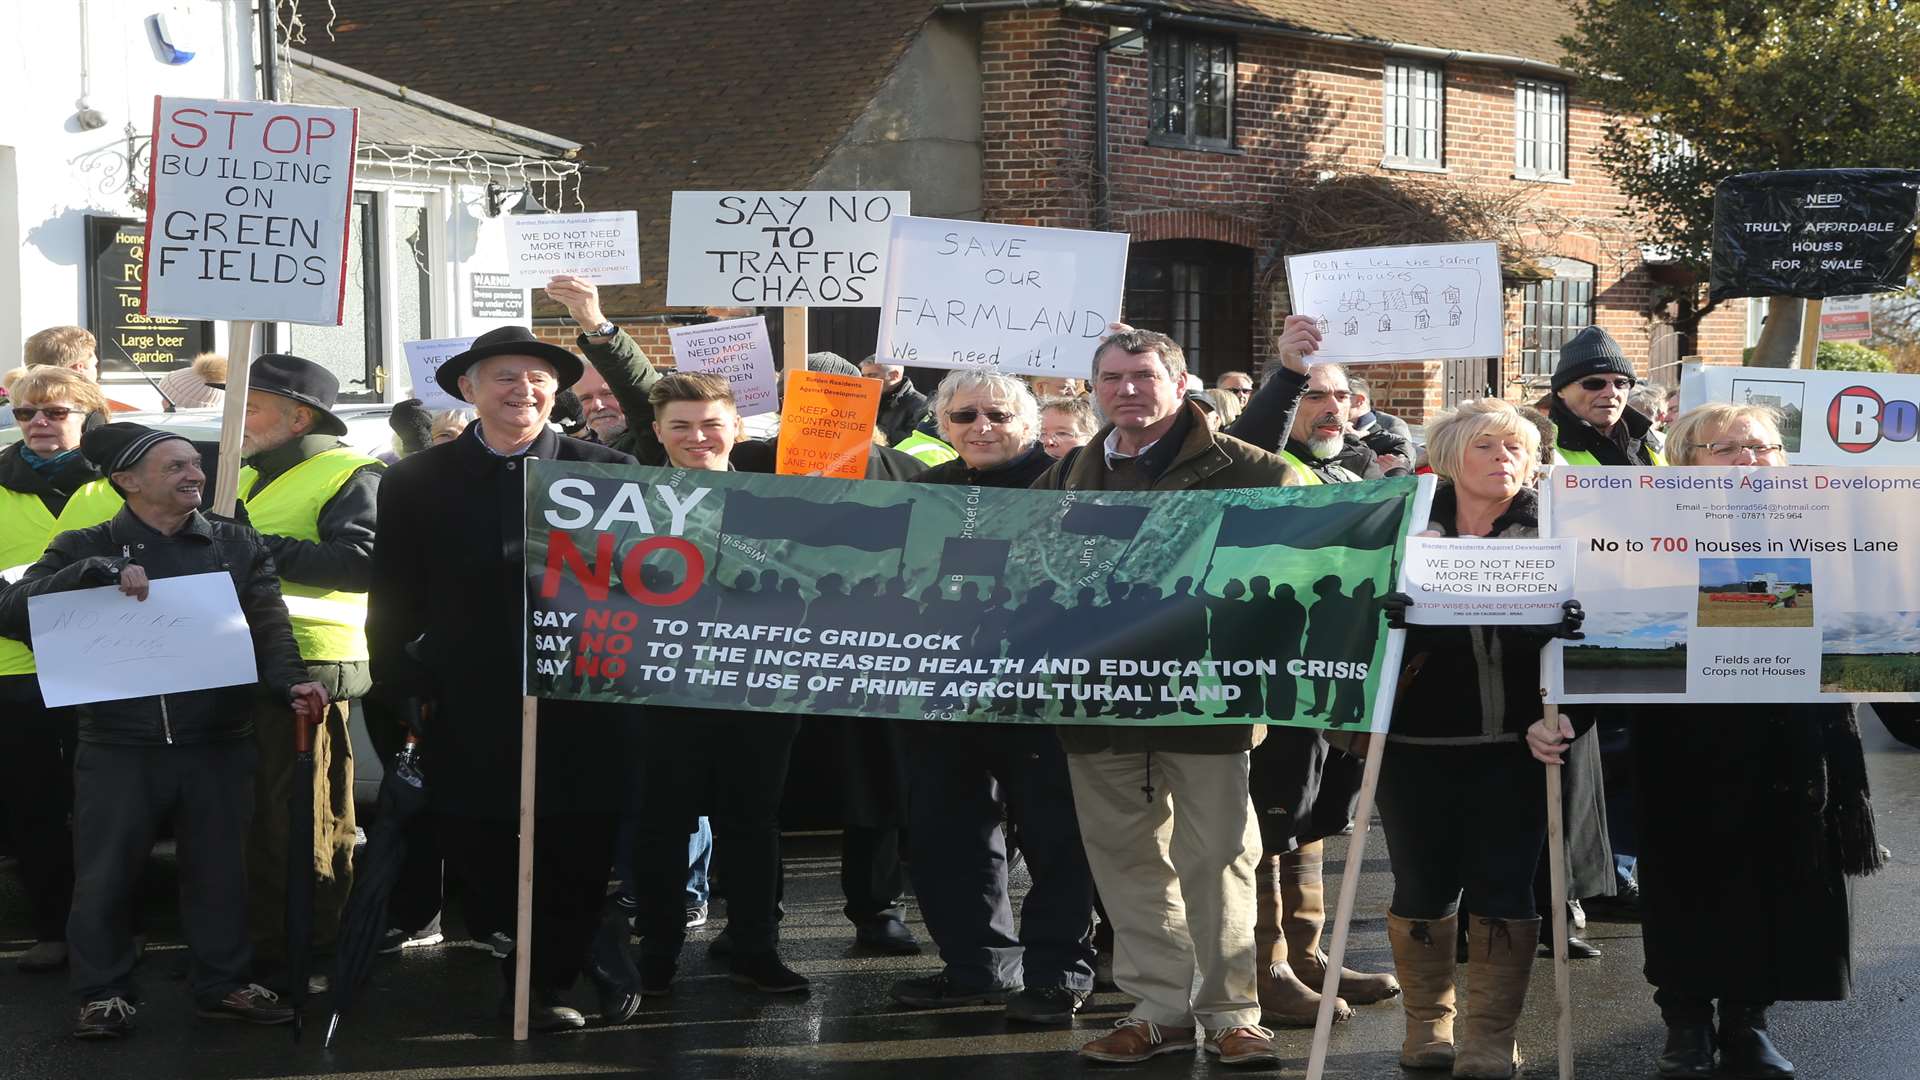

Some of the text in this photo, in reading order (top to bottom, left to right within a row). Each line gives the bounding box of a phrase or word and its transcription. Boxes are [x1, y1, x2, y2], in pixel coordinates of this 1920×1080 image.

[171, 108, 336, 155] STOP
[161, 154, 332, 184] BUILDING
[225, 185, 273, 208] ON
[1806, 193, 1843, 205] NEED
[715, 196, 892, 225] SAY NO
[165, 210, 319, 249] GREEN
[521, 229, 621, 241] WE DO NOT NEED
[1743, 222, 1895, 233] TRULY AFFORDABLE
[530, 239, 616, 251] MORE TRAFFIC
[761, 226, 814, 248] TO
[937, 232, 1027, 258] SAVE
[520, 249, 626, 262] CHAOS IN BORDEN
[1792, 241, 1844, 253] HOUSES
[160, 246, 327, 285] FIELDS
[705, 250, 879, 274] TRAFFIC
[1771, 259, 1864, 270] FOR SWALE
[984, 268, 1042, 289] OUR
[731, 275, 867, 303] CHAOS
[505, 300, 523, 309] CCTV
[895, 296, 1106, 339] FARMLAND
[121, 333, 185, 349] Large beer
[686, 331, 753, 347] WE DO NOT
[687, 341, 757, 358] NEED MORE
[890, 341, 918, 361] We
[952, 346, 1000, 365] need
[132, 351, 174, 366] garden
[700, 352, 749, 367] TRAFFIC
[699, 362, 754, 374] CHAOS IN
[744, 391, 771, 401] NOW
[799, 405, 857, 420] KEEP OUR
[787, 414, 868, 432] COUNTRYSIDE
[801, 427, 841, 440] GREEN
[802, 448, 816, 458] TO
[1565, 474, 1920, 492] Borden Residents Against Developme
[967, 485, 981, 505] Clu
[544, 478, 713, 536] SAY
[1676, 503, 1701, 511] Email
[1080, 538, 1096, 568] Jim &
[1590, 537, 1899, 552] No to 700 houses in Wises Lane
[540, 530, 705, 607] NO
[1426, 559, 1556, 569] WE DO NOT NEED
[1076, 571, 1099, 589] The
[1435, 571, 1545, 581] MORE TRAFFIC
[1421, 583, 1558, 592] CHAOS IN BORDEN
[52, 608, 99, 632] NO
[533, 607, 963, 651] SAY NO TO TRAFFIC GRIDLOCK
[535, 631, 1369, 681] SAY NO TO THE INCREASED HEALTH AND EDUCATION CRISIS
[1714, 655, 1750, 664] Fields
[1775, 655, 1792, 664] for
[536, 655, 1242, 702] SAY NO TO THE USE OF PRIME AGRCULTURAL LAND
[1702, 666, 1806, 677] Crops not Houses
